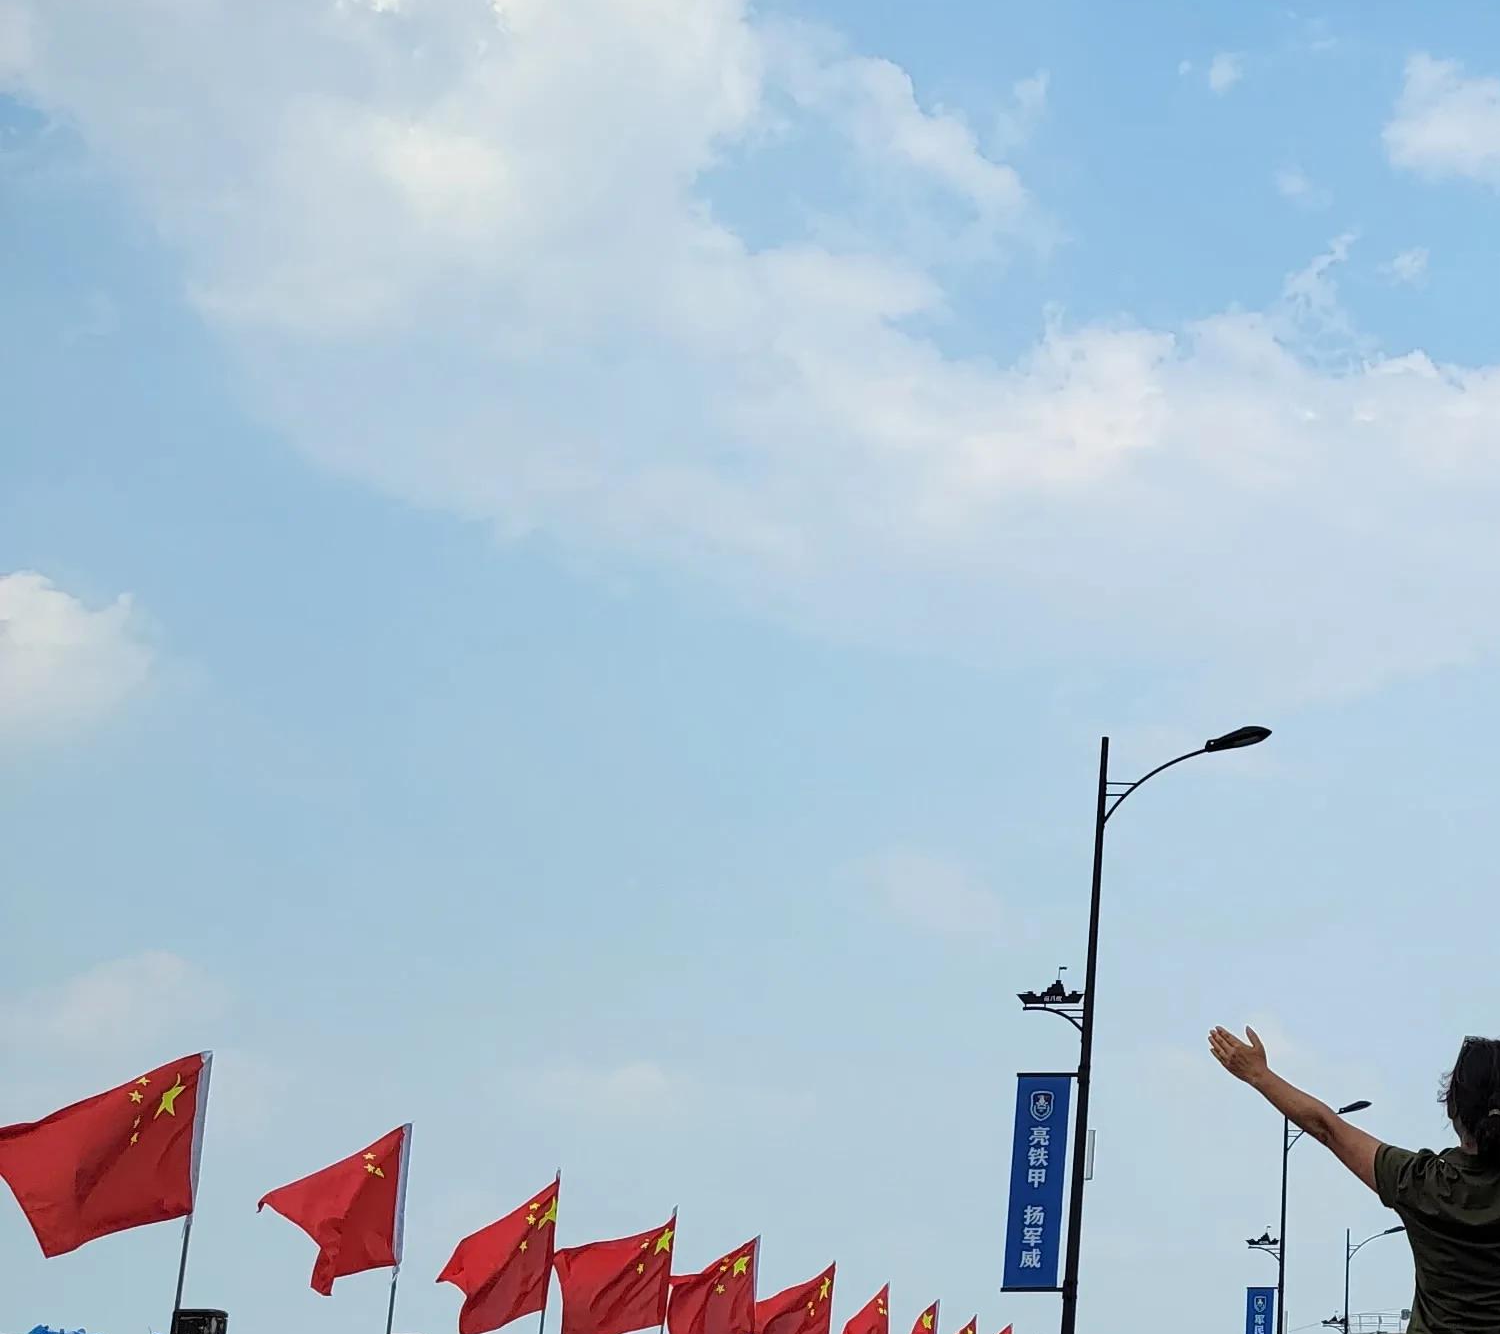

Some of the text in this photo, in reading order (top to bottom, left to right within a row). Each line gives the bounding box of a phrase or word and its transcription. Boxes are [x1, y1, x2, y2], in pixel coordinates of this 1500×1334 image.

[1019, 1126, 1051, 1269] 亮铁甲 扬军威
